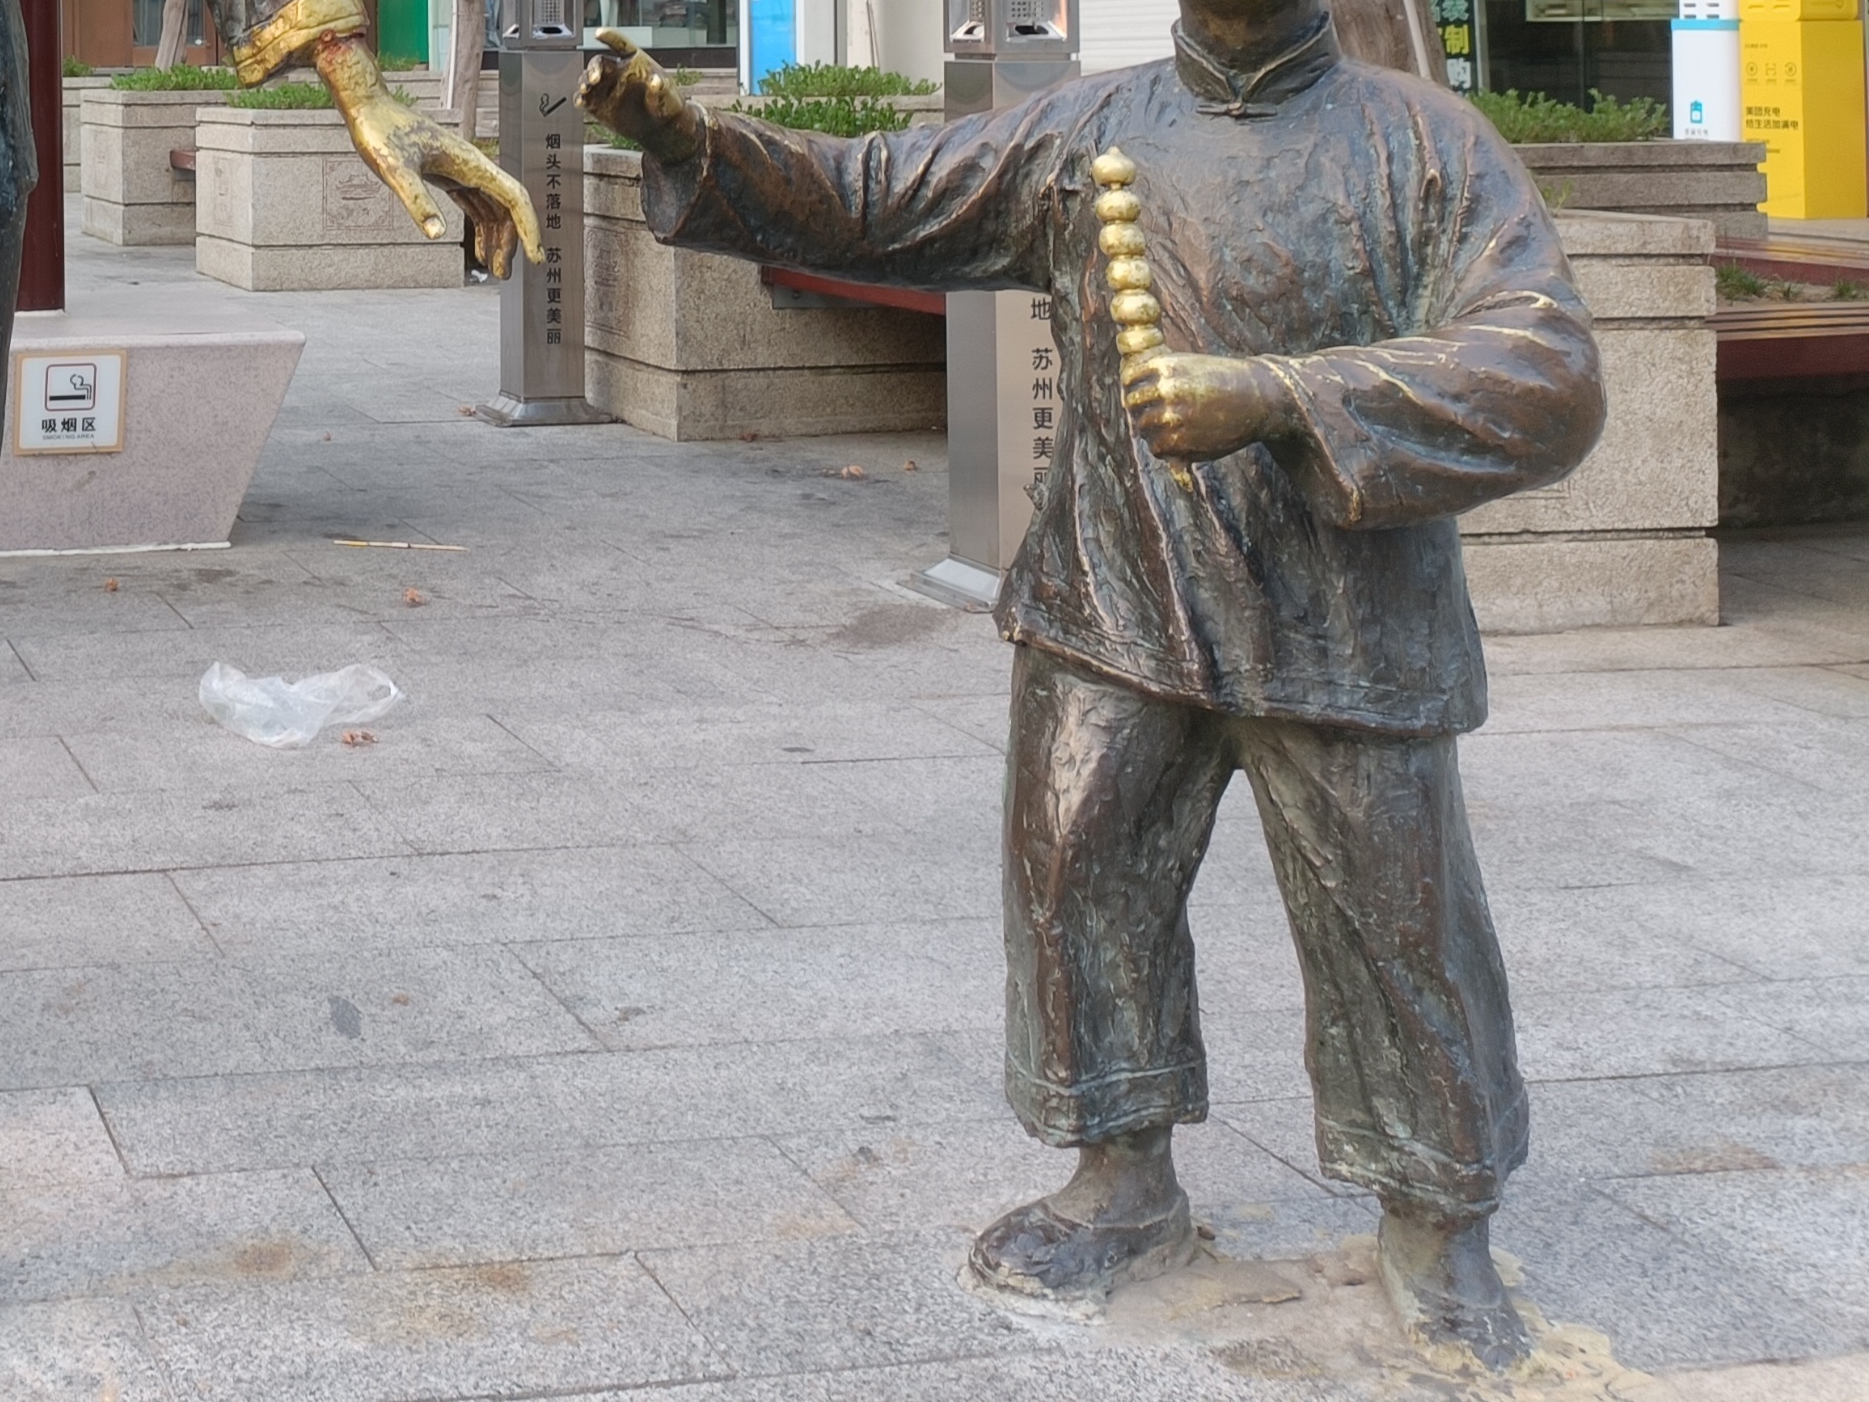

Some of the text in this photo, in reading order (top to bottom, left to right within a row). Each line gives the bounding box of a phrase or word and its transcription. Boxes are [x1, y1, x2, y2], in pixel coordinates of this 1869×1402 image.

[1437, 24, 1471, 55] 制
[545, 133, 562, 345] 烟头不落地 苏州更美丽
[41, 416, 97, 434] 吸烟区
